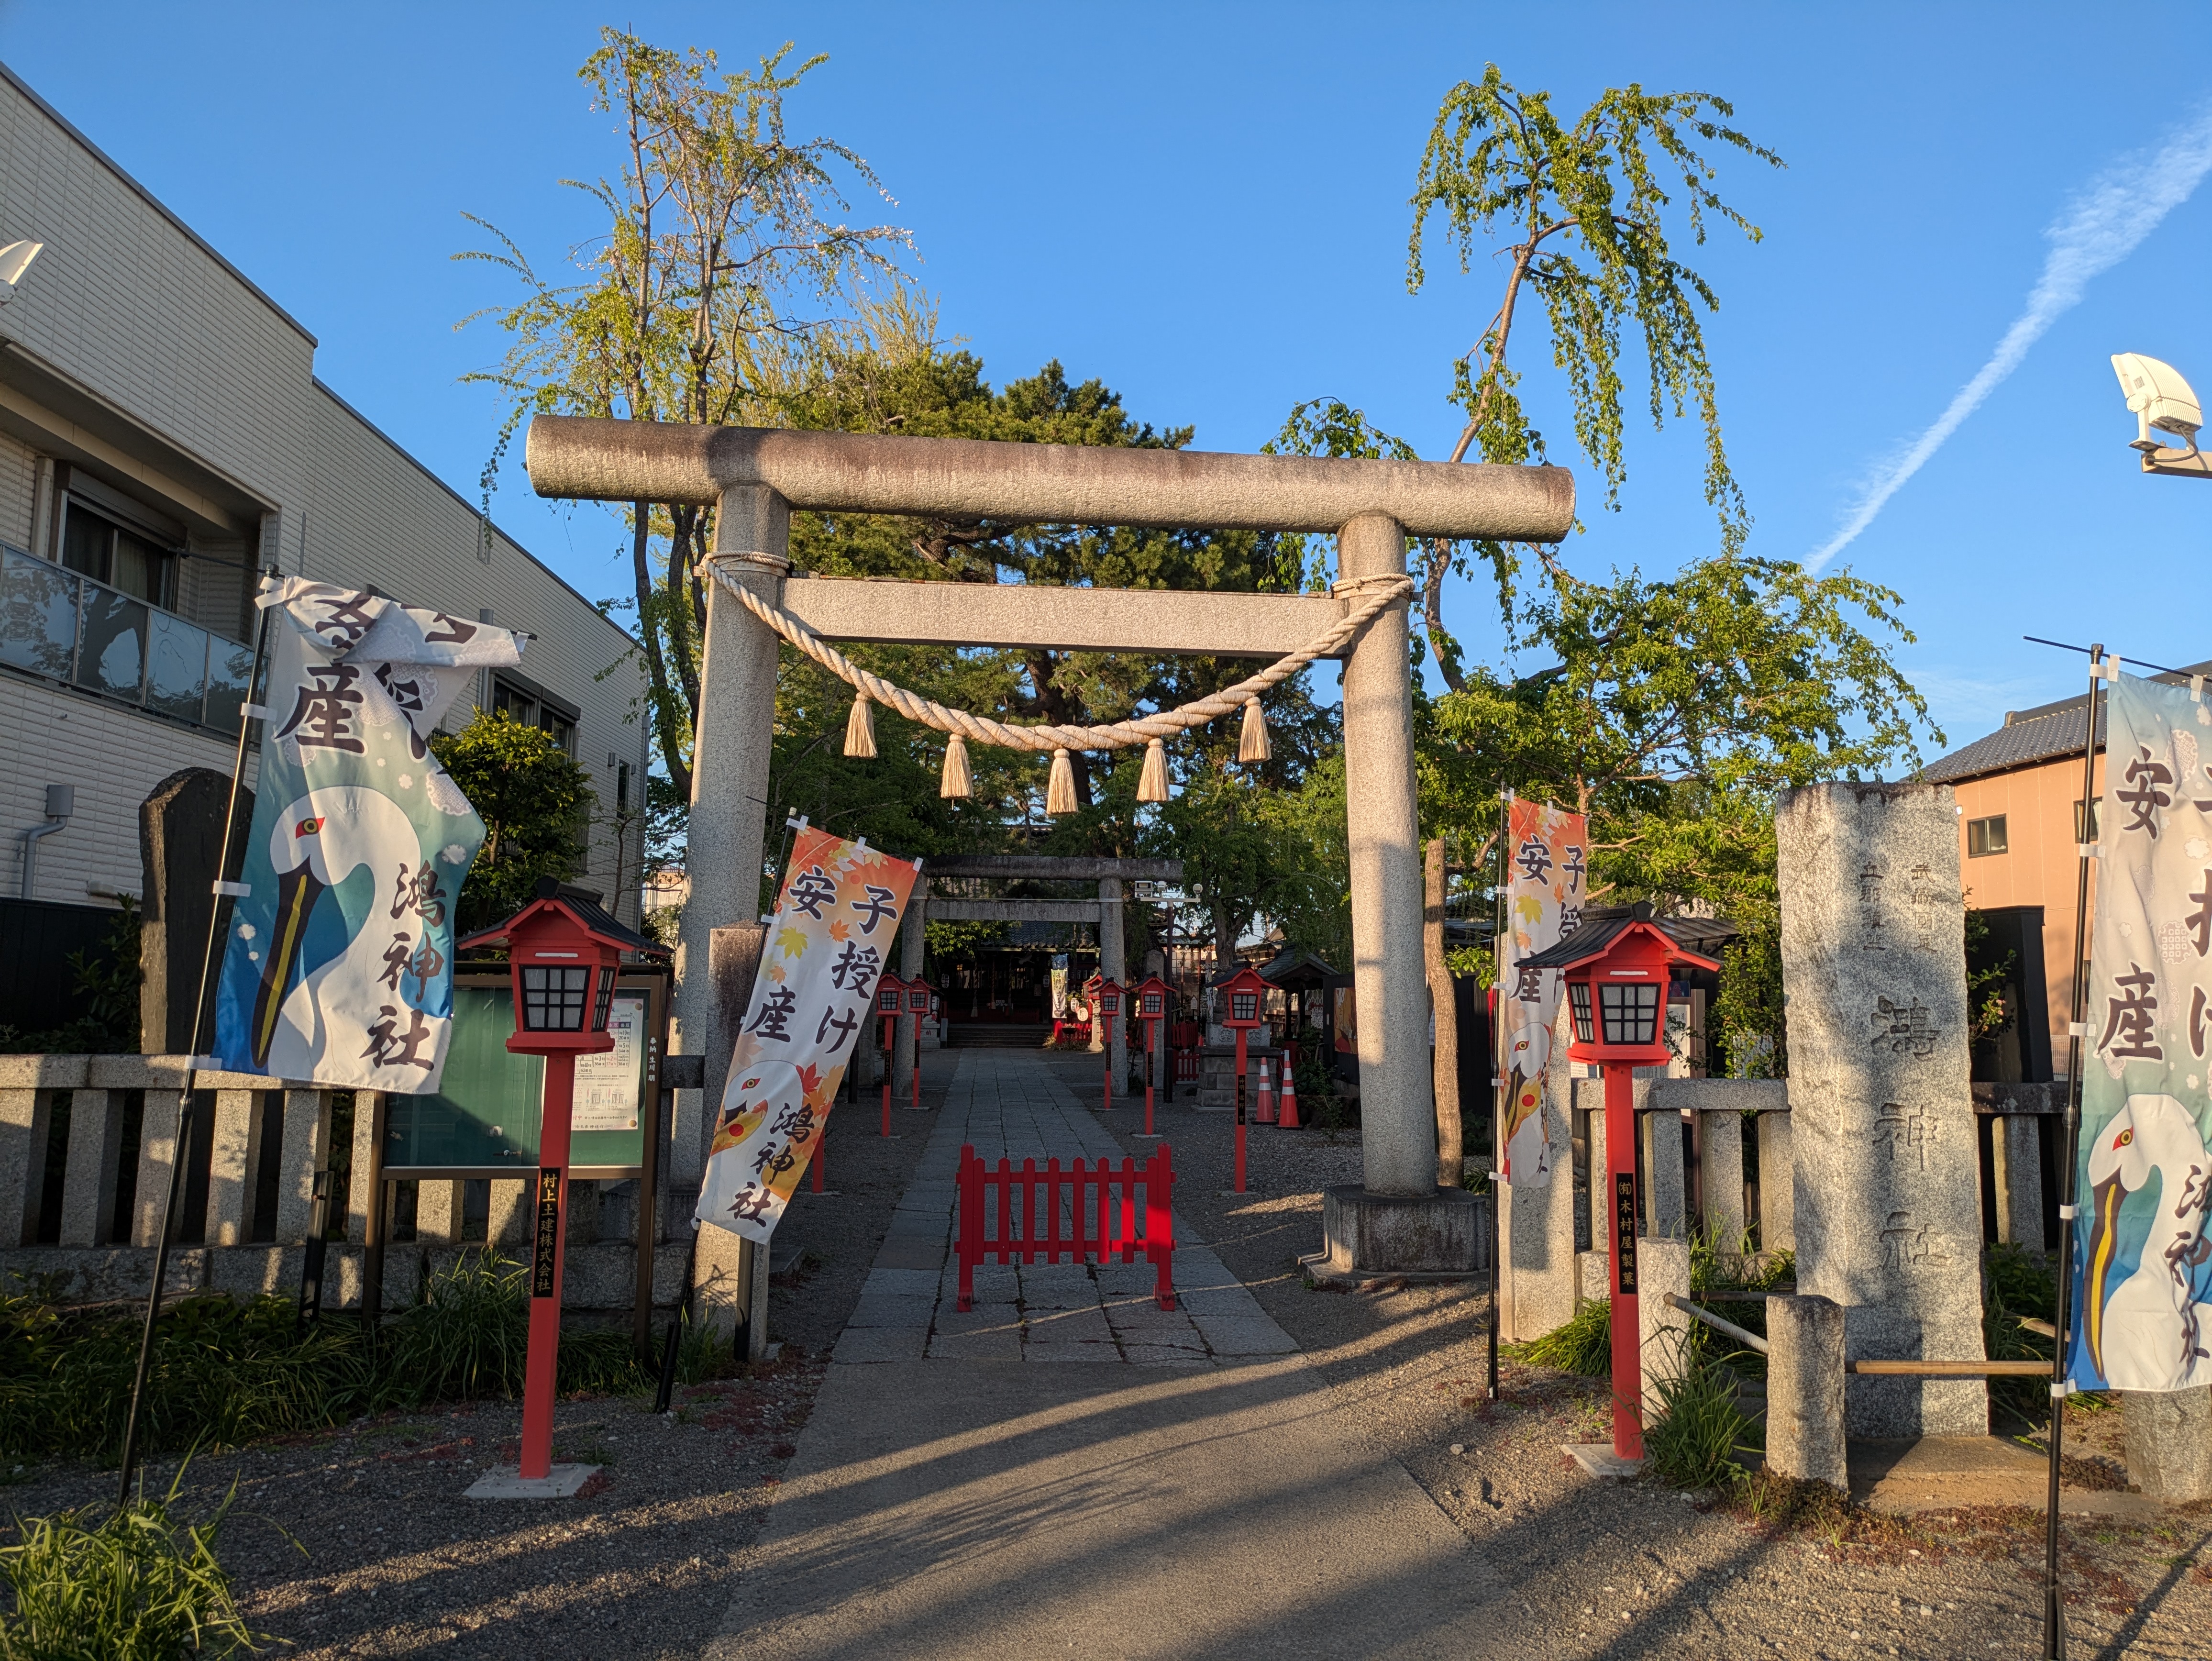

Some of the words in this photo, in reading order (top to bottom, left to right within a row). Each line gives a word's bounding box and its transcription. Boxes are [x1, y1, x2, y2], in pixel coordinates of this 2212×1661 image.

[359, 860, 446, 1070] 鴻神社
[745, 867, 836, 1041] 安産
[816, 886, 897, 1052] 子授け
[649, 1037, 657, 1053] 奉納
[649, 1055, 656, 1072] 生川
[731, 1102, 815, 1227] 鴻神社
[1871, 996, 1953, 1273] 鴻神社
[537, 1173, 557, 1292] 村上土建株式会社
